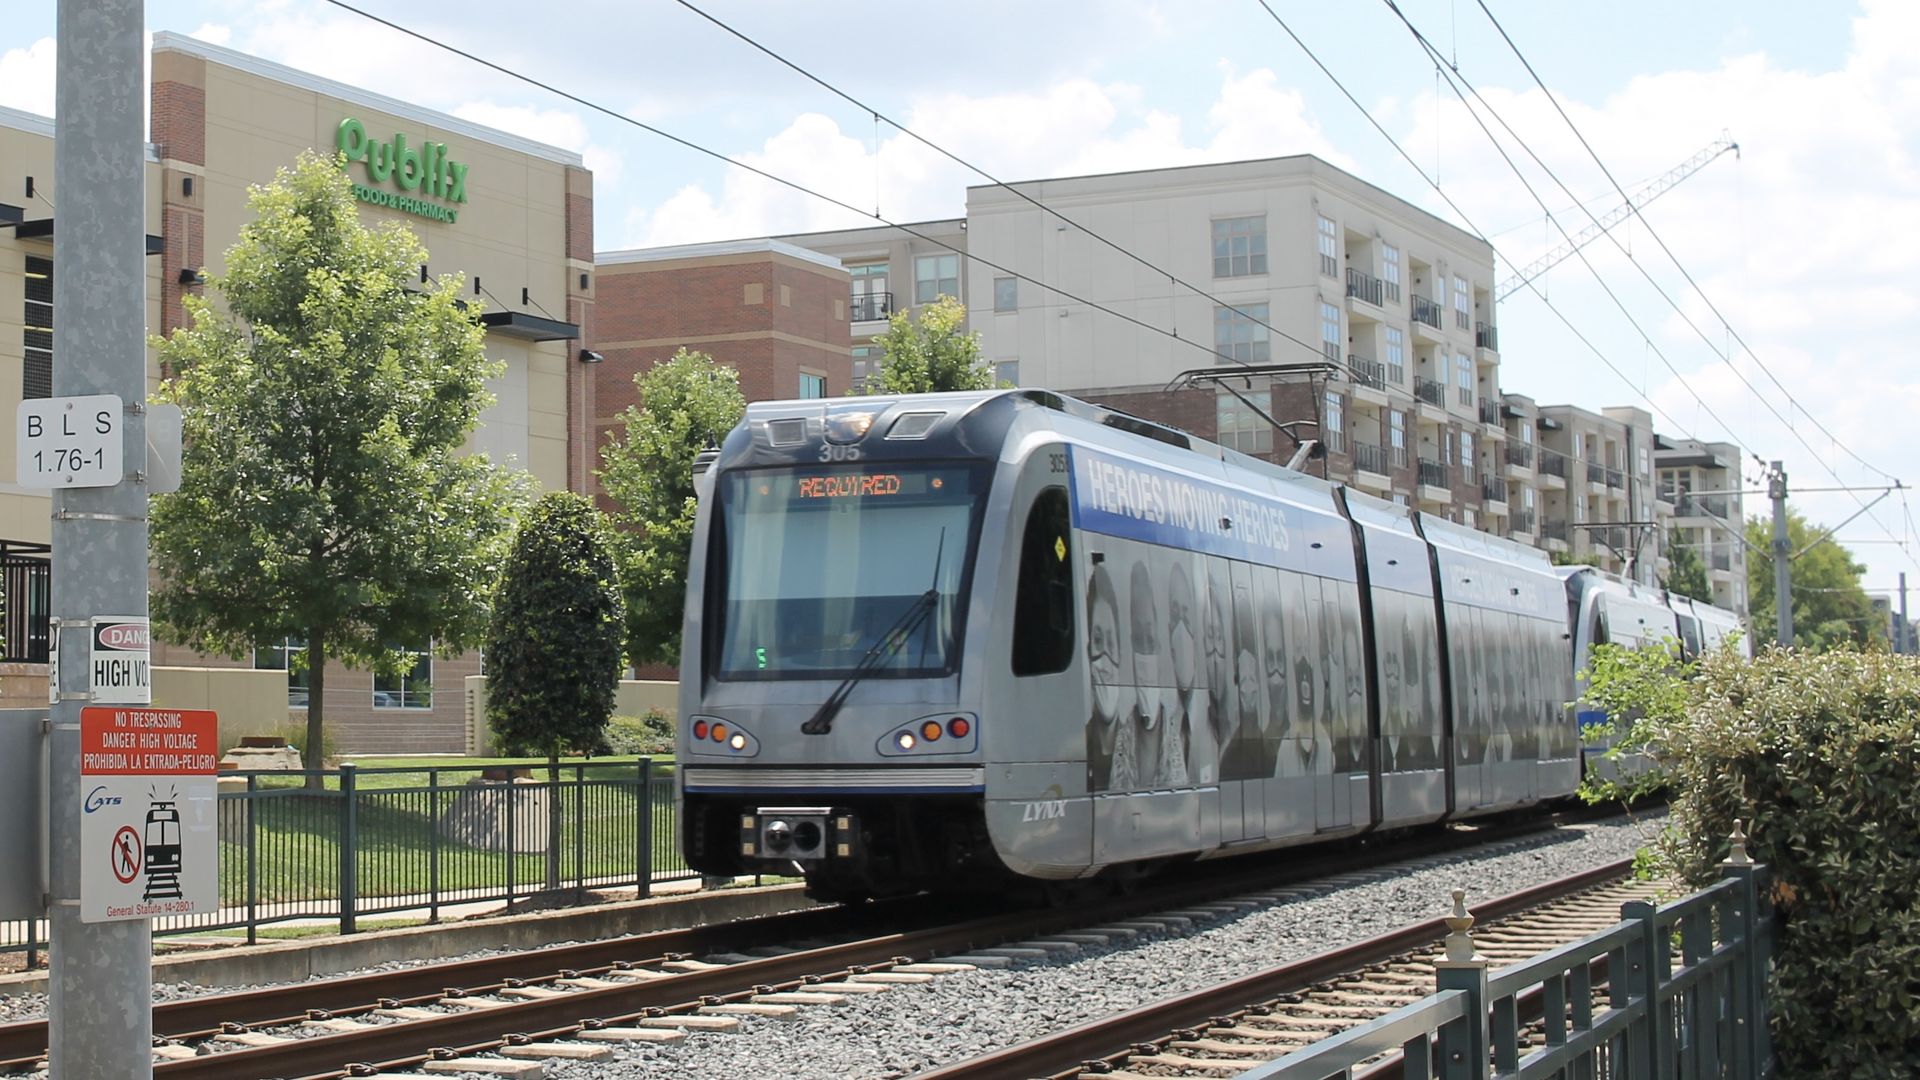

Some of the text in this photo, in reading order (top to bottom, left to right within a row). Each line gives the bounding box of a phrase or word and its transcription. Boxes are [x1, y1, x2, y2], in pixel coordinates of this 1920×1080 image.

[337, 118, 468, 204] Publix
[355, 185, 459, 223] FOOD & PHARMACY
[34, 447, 104, 472] 1.76-1
[818, 444, 861, 462] 305
[799, 474, 901, 497] REQUIRED
[1087, 459, 1290, 551] HEROES MOVING HEROES
[94, 659, 149, 687] HIGH VO
[115, 711, 182, 729] NO TRESPASSING
[102, 732, 197, 749] DANGER HIGH VOLTAGE
[84, 753, 216, 769] PROHIBIDA LA ENTRADA-PELIGRO
[1022, 800, 1069, 822] LYNX
[107, 901, 195, 917] General Statute 14-280.1
